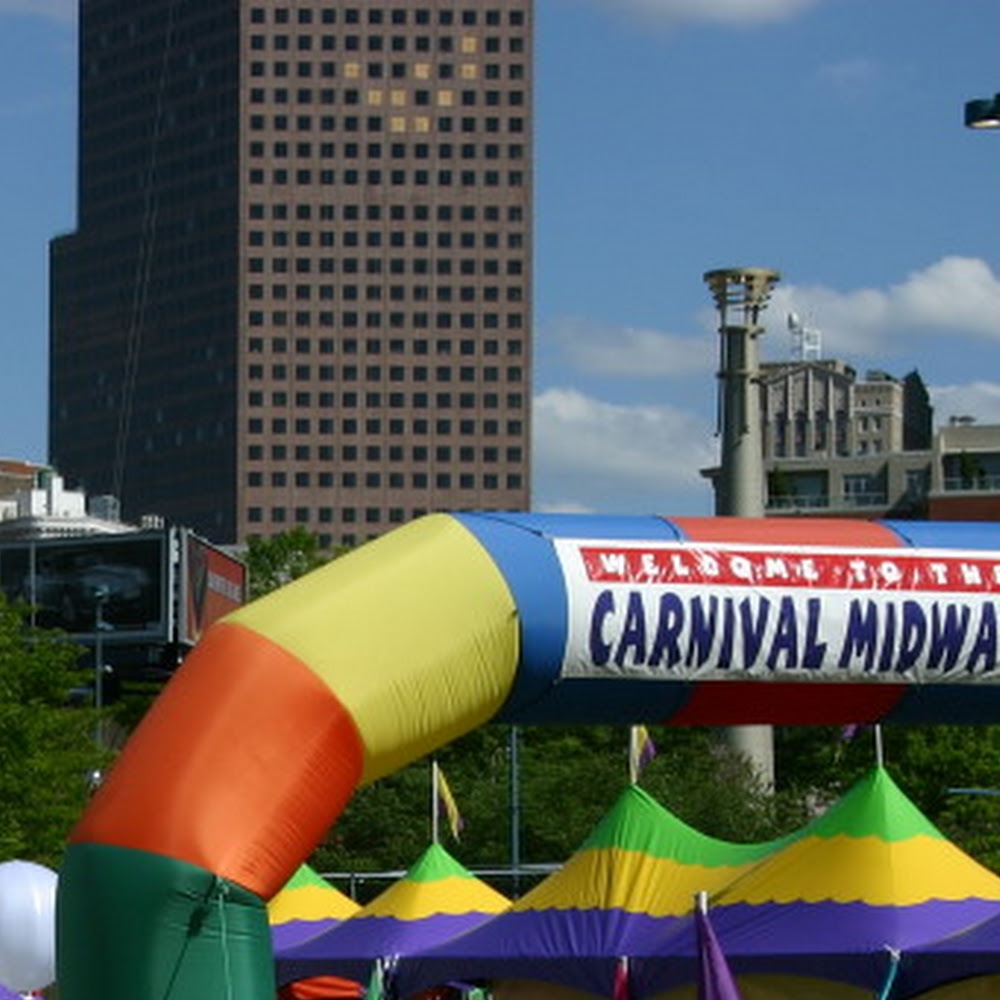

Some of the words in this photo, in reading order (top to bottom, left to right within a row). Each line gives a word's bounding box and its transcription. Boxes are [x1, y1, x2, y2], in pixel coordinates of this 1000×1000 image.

[600, 553, 818, 581] WELCOME
[850, 560, 900, 584] TO
[589, 590, 827, 671] CARNIVAL
[839, 598, 998, 675] MIDWA
